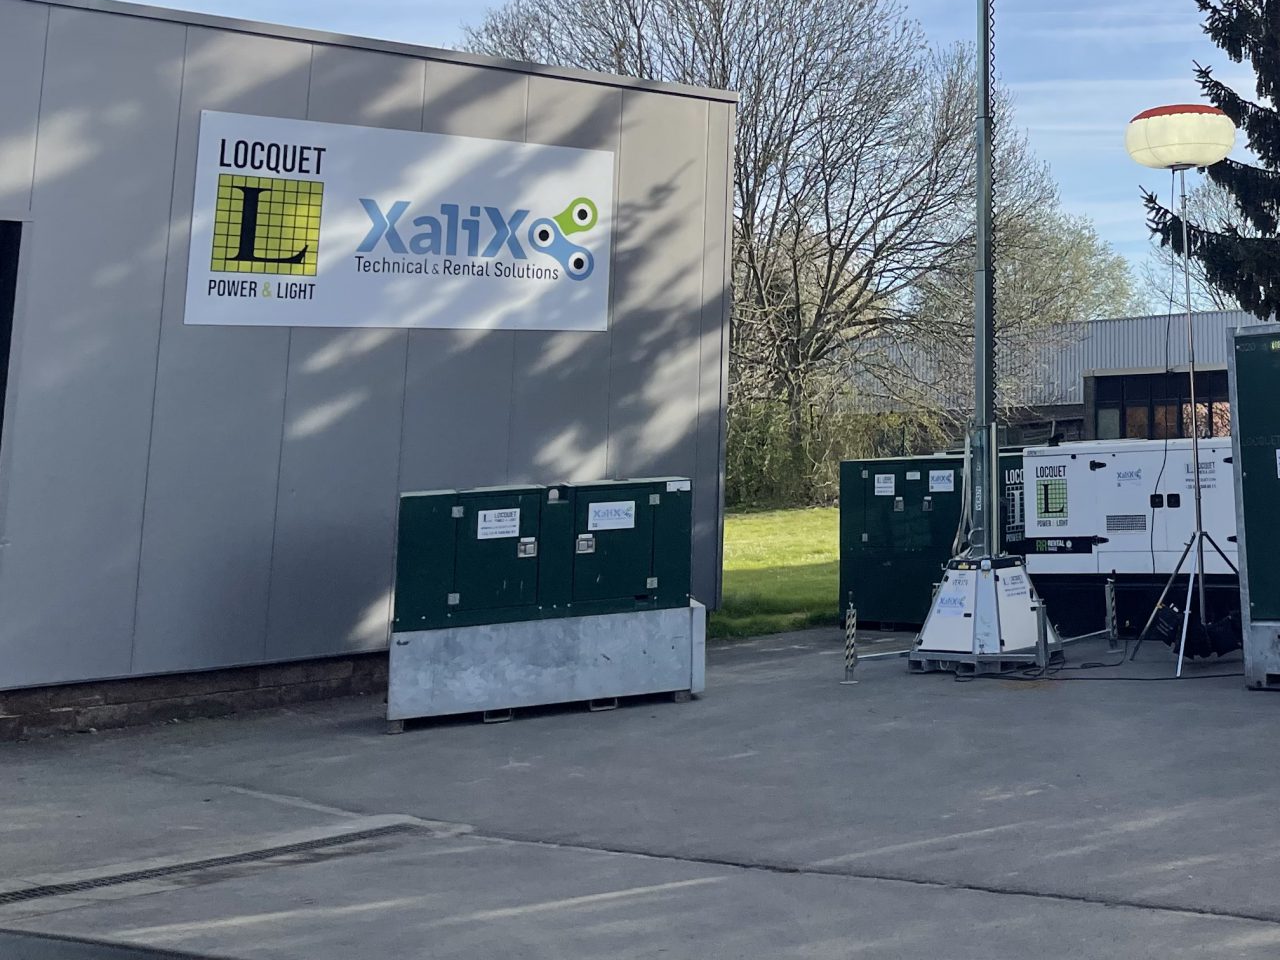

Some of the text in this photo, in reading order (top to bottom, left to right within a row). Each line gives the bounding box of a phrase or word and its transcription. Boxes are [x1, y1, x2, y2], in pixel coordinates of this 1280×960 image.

[219, 139, 327, 175] LOCQUET
[225, 186, 309, 265] L
[355, 256, 559, 281] Technical & Rental Solutions
[208, 279, 316, 300] POWER & LIGHT
[1036, 466, 1067, 478] LOCQUET
